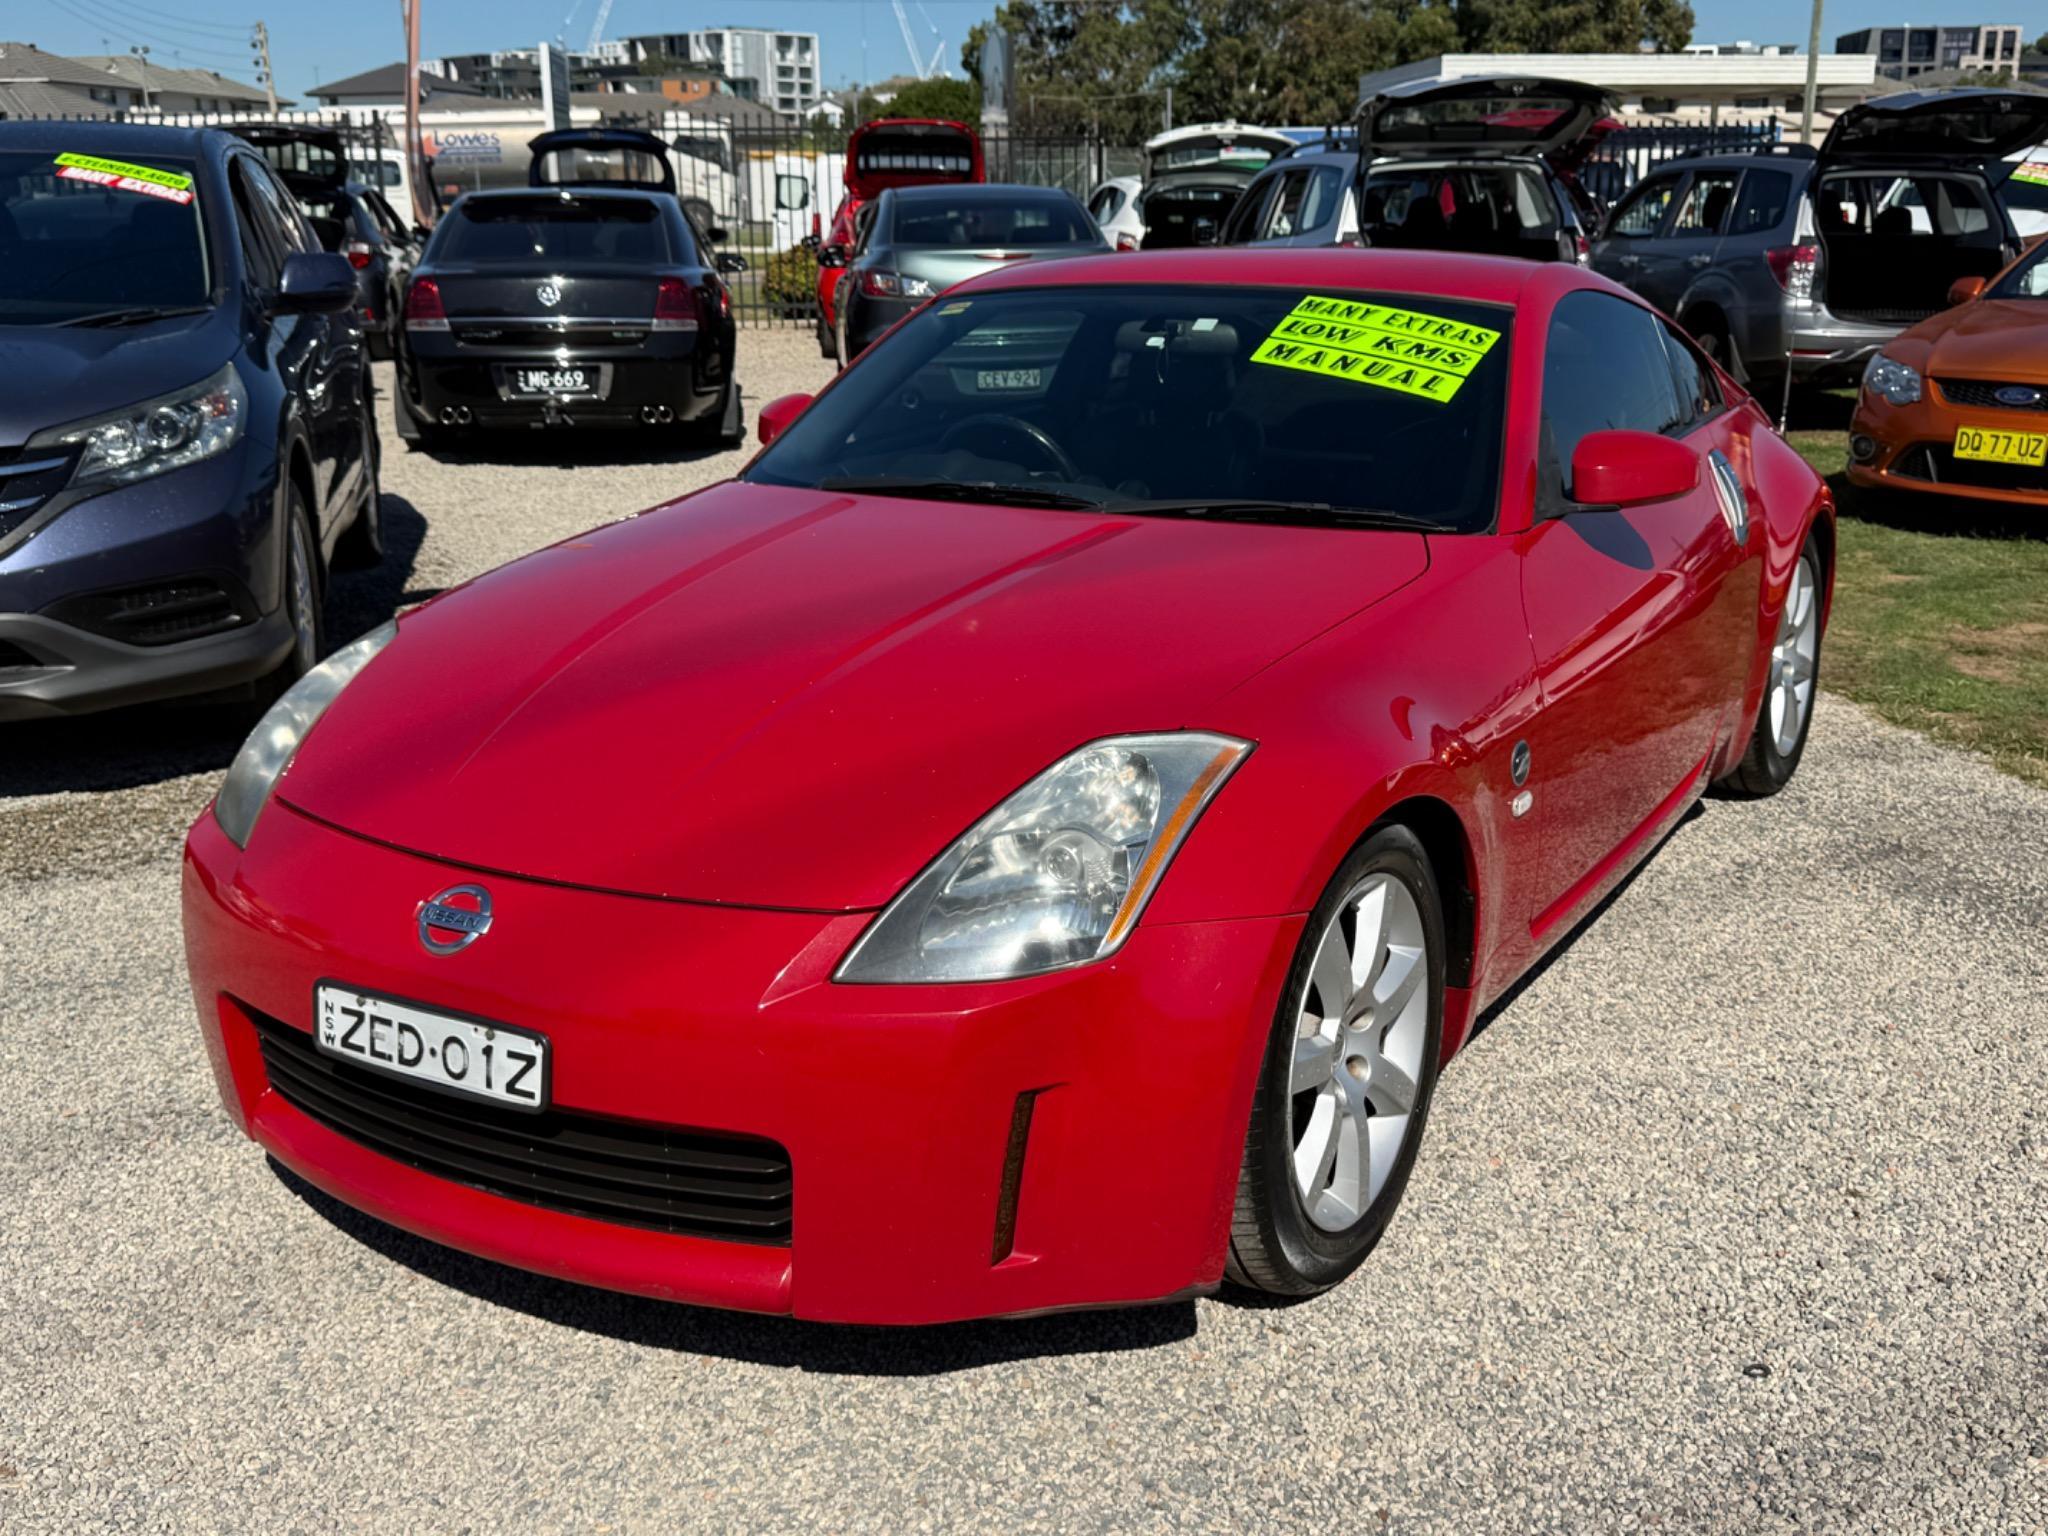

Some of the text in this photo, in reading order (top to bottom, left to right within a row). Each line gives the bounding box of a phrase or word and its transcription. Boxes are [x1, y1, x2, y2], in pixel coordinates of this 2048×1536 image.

[434, 130, 500, 146] Lowes
[1282, 320, 1472, 368] LOW KMS
[1300, 299, 1491, 347] MANY EXTRAS
[1265, 343, 1446, 393] MANUAL
[424, 907, 479, 929] NISSAN
